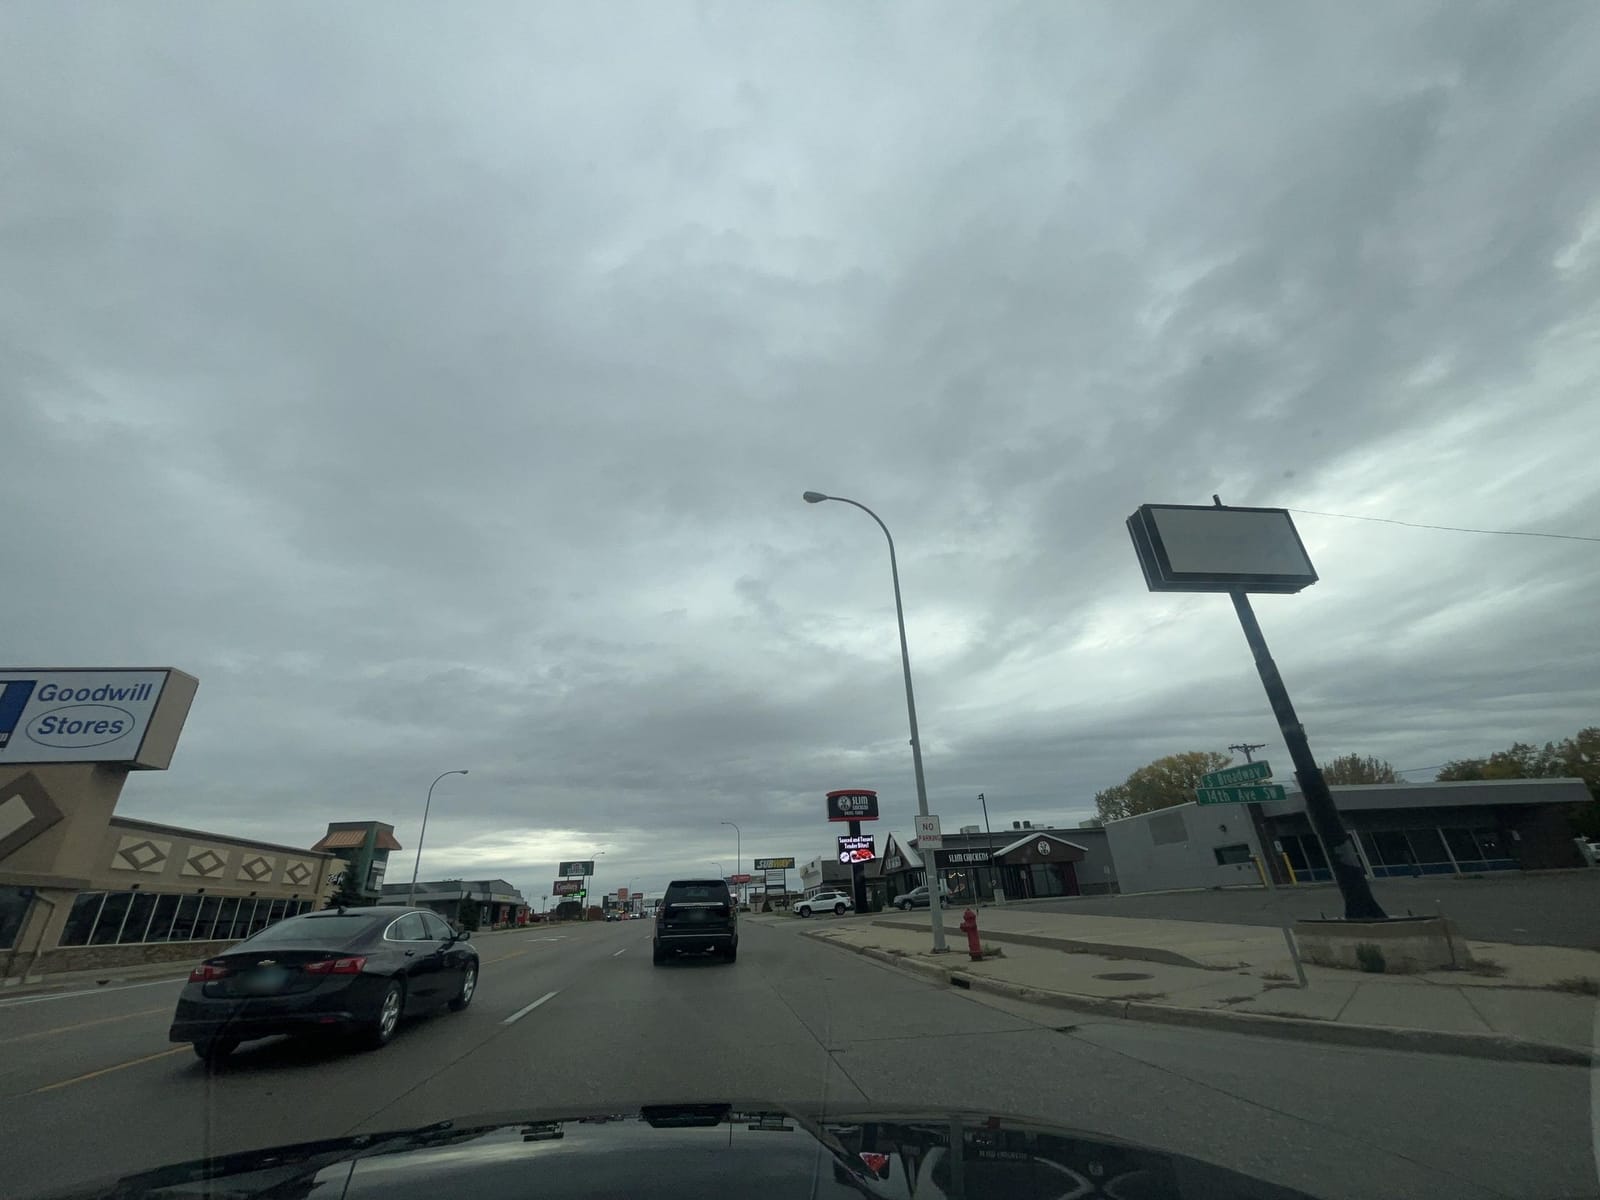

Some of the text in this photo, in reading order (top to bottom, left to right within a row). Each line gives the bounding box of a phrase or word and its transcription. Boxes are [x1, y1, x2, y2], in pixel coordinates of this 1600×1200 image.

[37, 683, 153, 701] Goodwill
[37, 716, 124, 735] Stores
[1207, 767, 1260, 787] S Broadway
[1206, 787, 1277, 802] 14th Ave SW
[852, 796, 868, 805] SLIM
[922, 822, 934, 831] NO
[918, 834, 942, 842] PARKING
[948, 853, 963, 863] SLIM
[756, 859, 790, 869] SUBWAY
